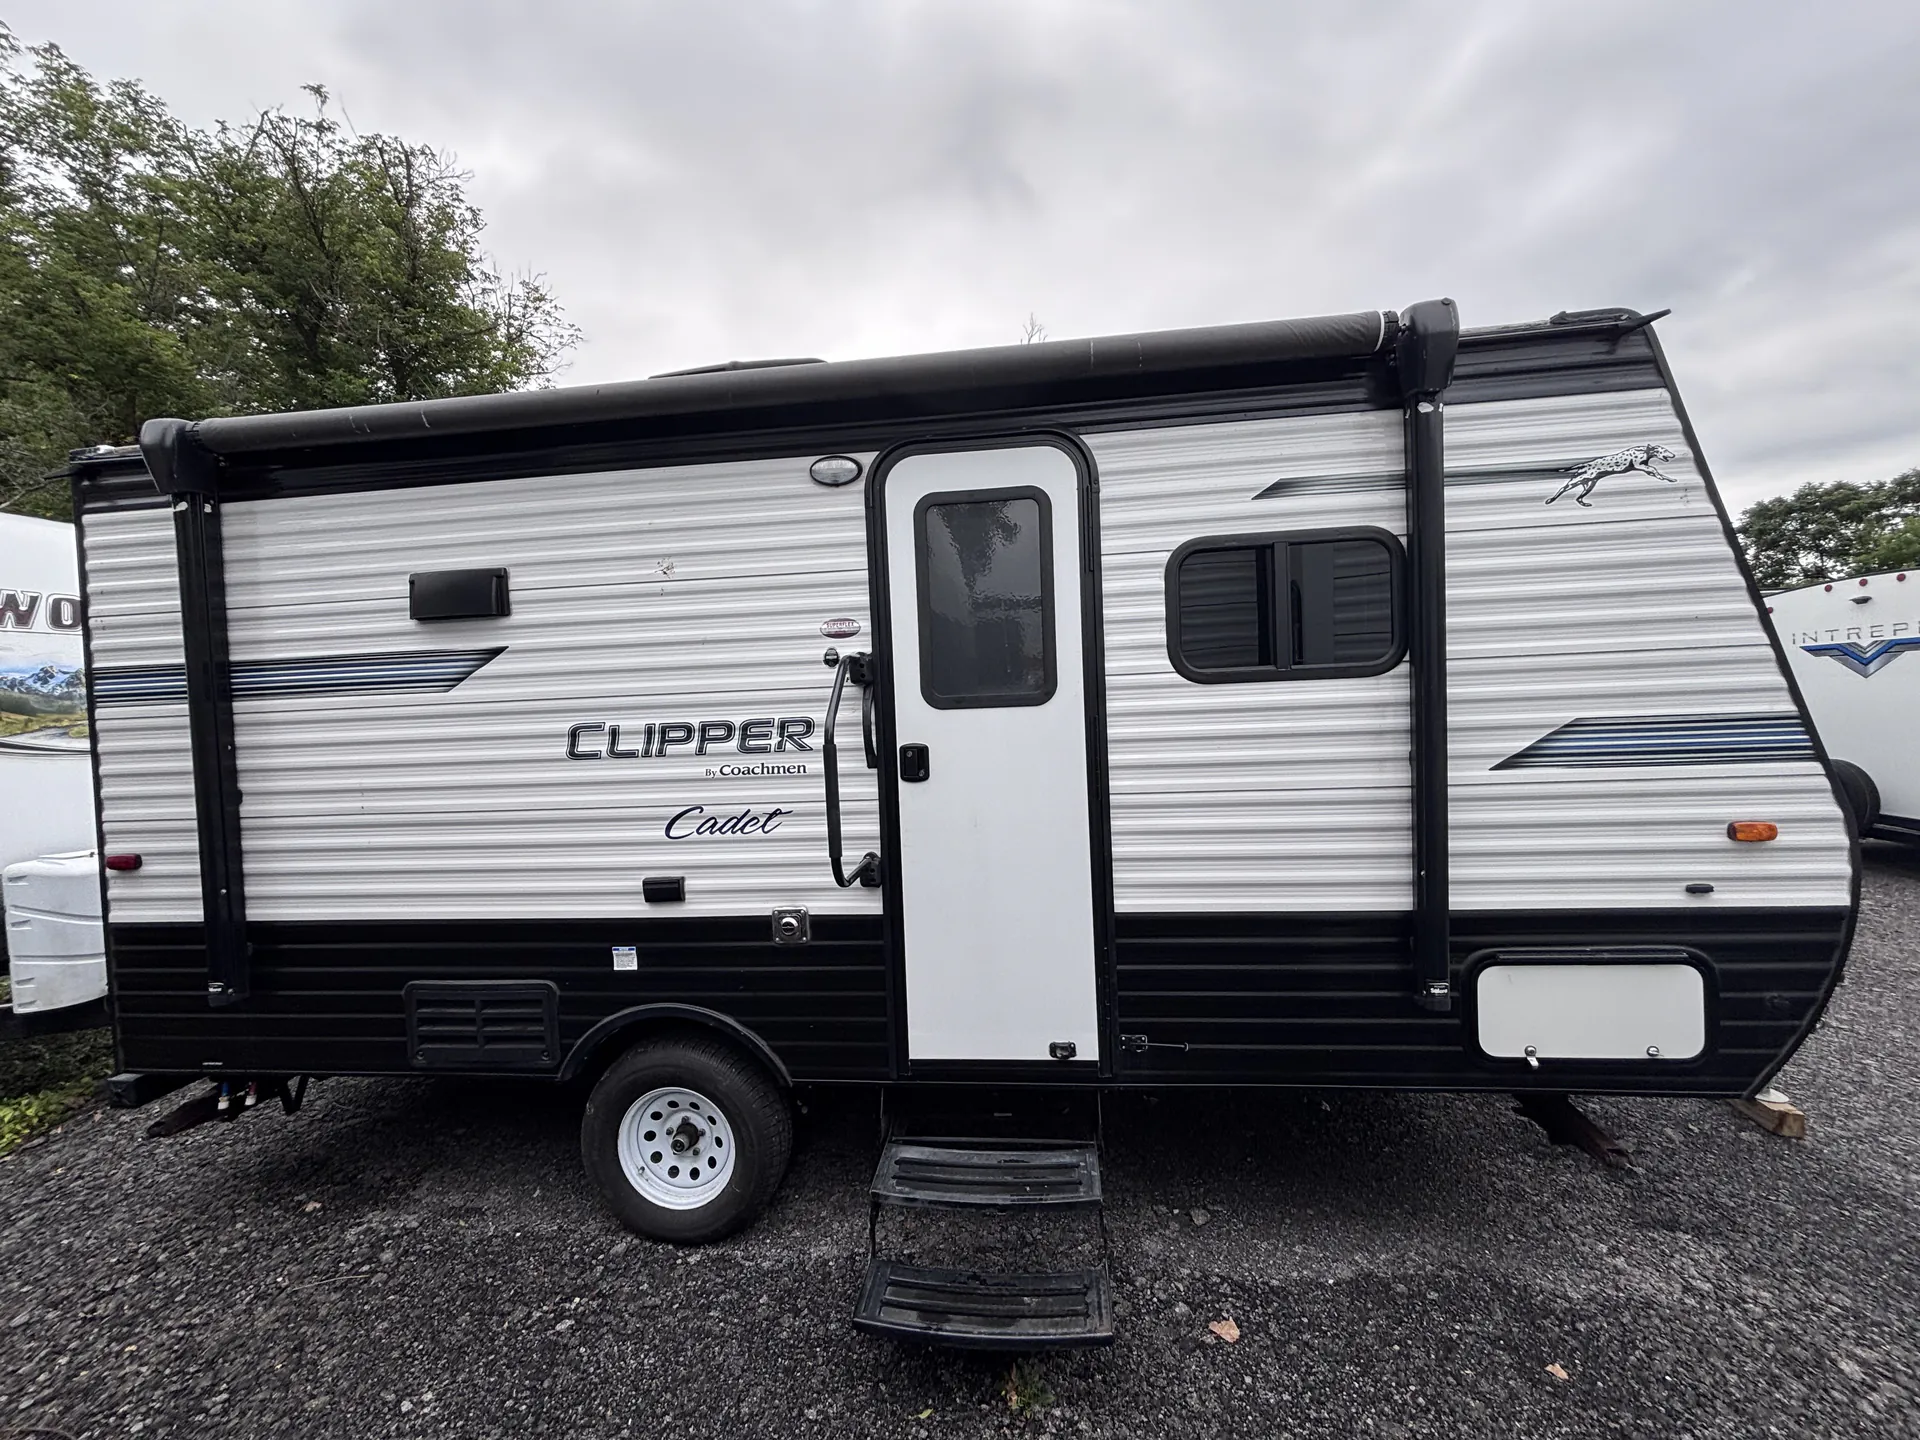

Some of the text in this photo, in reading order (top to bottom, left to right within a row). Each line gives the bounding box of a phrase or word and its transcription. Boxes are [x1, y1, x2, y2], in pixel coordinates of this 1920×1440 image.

[565, 716, 816, 760] CLIPPER
[704, 762, 808, 779] By Coachmen
[664, 805, 794, 840] Cadet
